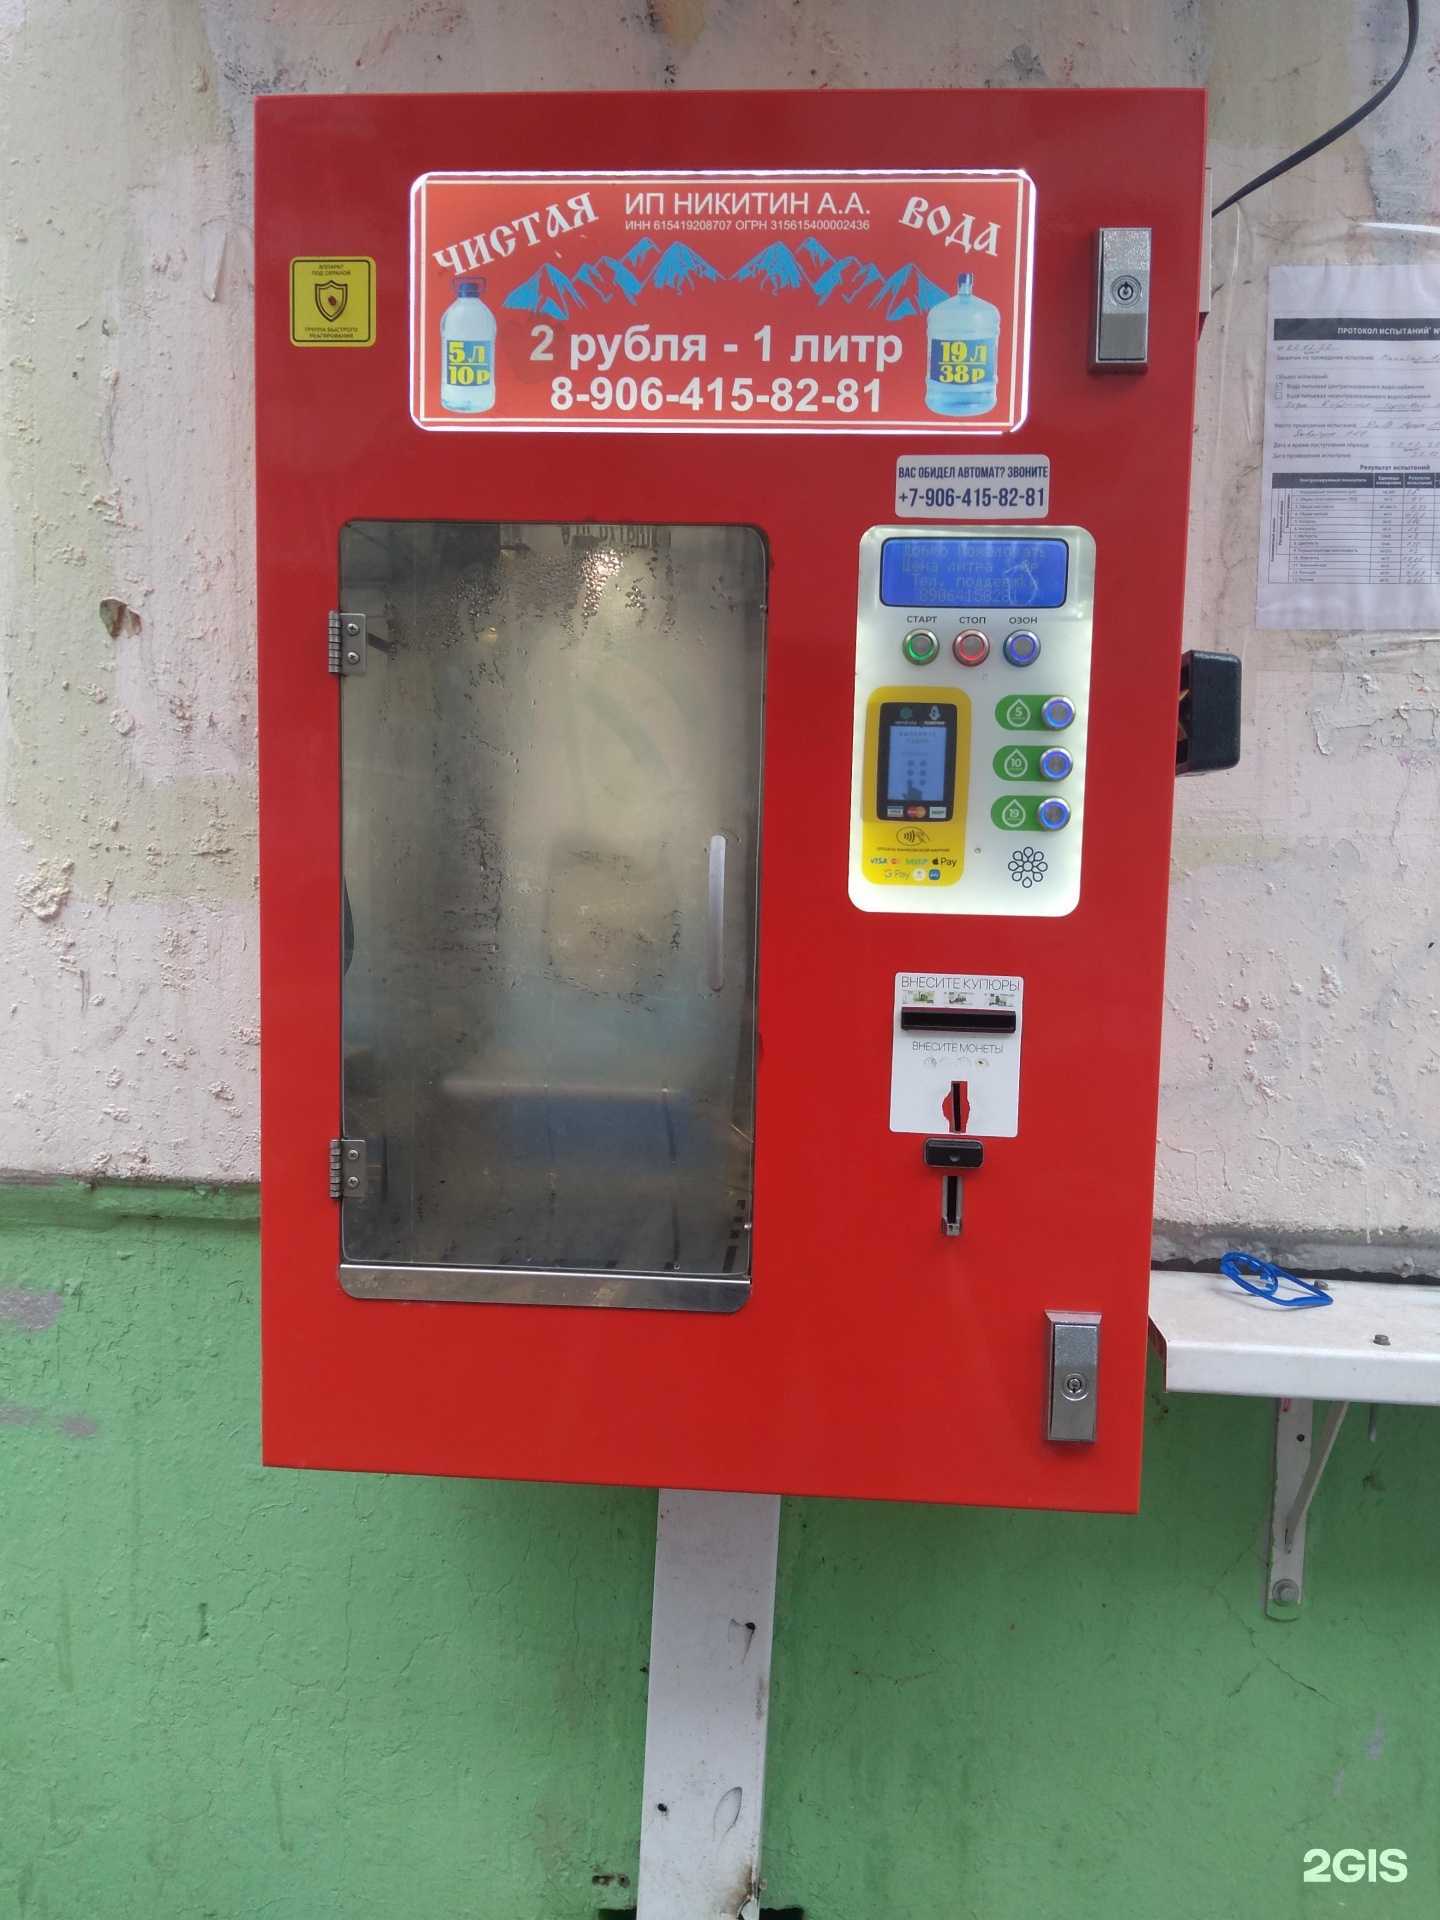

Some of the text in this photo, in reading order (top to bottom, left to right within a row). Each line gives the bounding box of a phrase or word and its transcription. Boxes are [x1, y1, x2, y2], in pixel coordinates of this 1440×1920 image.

[624, 192, 871, 215] ИП НИКИТИН А.А.
[625, 220, 651, 231] ИНН
[653, 220, 732, 231] 615419208707
[735, 220, 768, 231] ОГРН
[899, 196, 1001, 256] ВОДА
[432, 192, 599, 276] ЧИСТАЯ
[1337, 327, 1378, 335] ПРОТОКОЛ
[529, 324, 903, 372] 2 рубля - 1 литр
[550, 376, 880, 412] 8-906-415-82-81
[898, 465, 1049, 480] ВАС ОБИДЕЛ АВТОМАТ? ЗВОНИТЕ
[898, 488, 1045, 507] +7-906-415-82-81
[906, 615, 938, 624] СТАРТ
[959, 616, 986, 625] СТОП
[1008, 616, 1038, 625] ОЗОН
[1015, 706, 1023, 717] 5
[1011, 758, 1022, 768] 10
[940, 857, 957, 867] Pay
[901, 976, 1021, 992] ВНЕСИТЕ КУПЮРЫ
[912, 1041, 1004, 1054] ВНЕСИТЕ МОНЕТЫ
